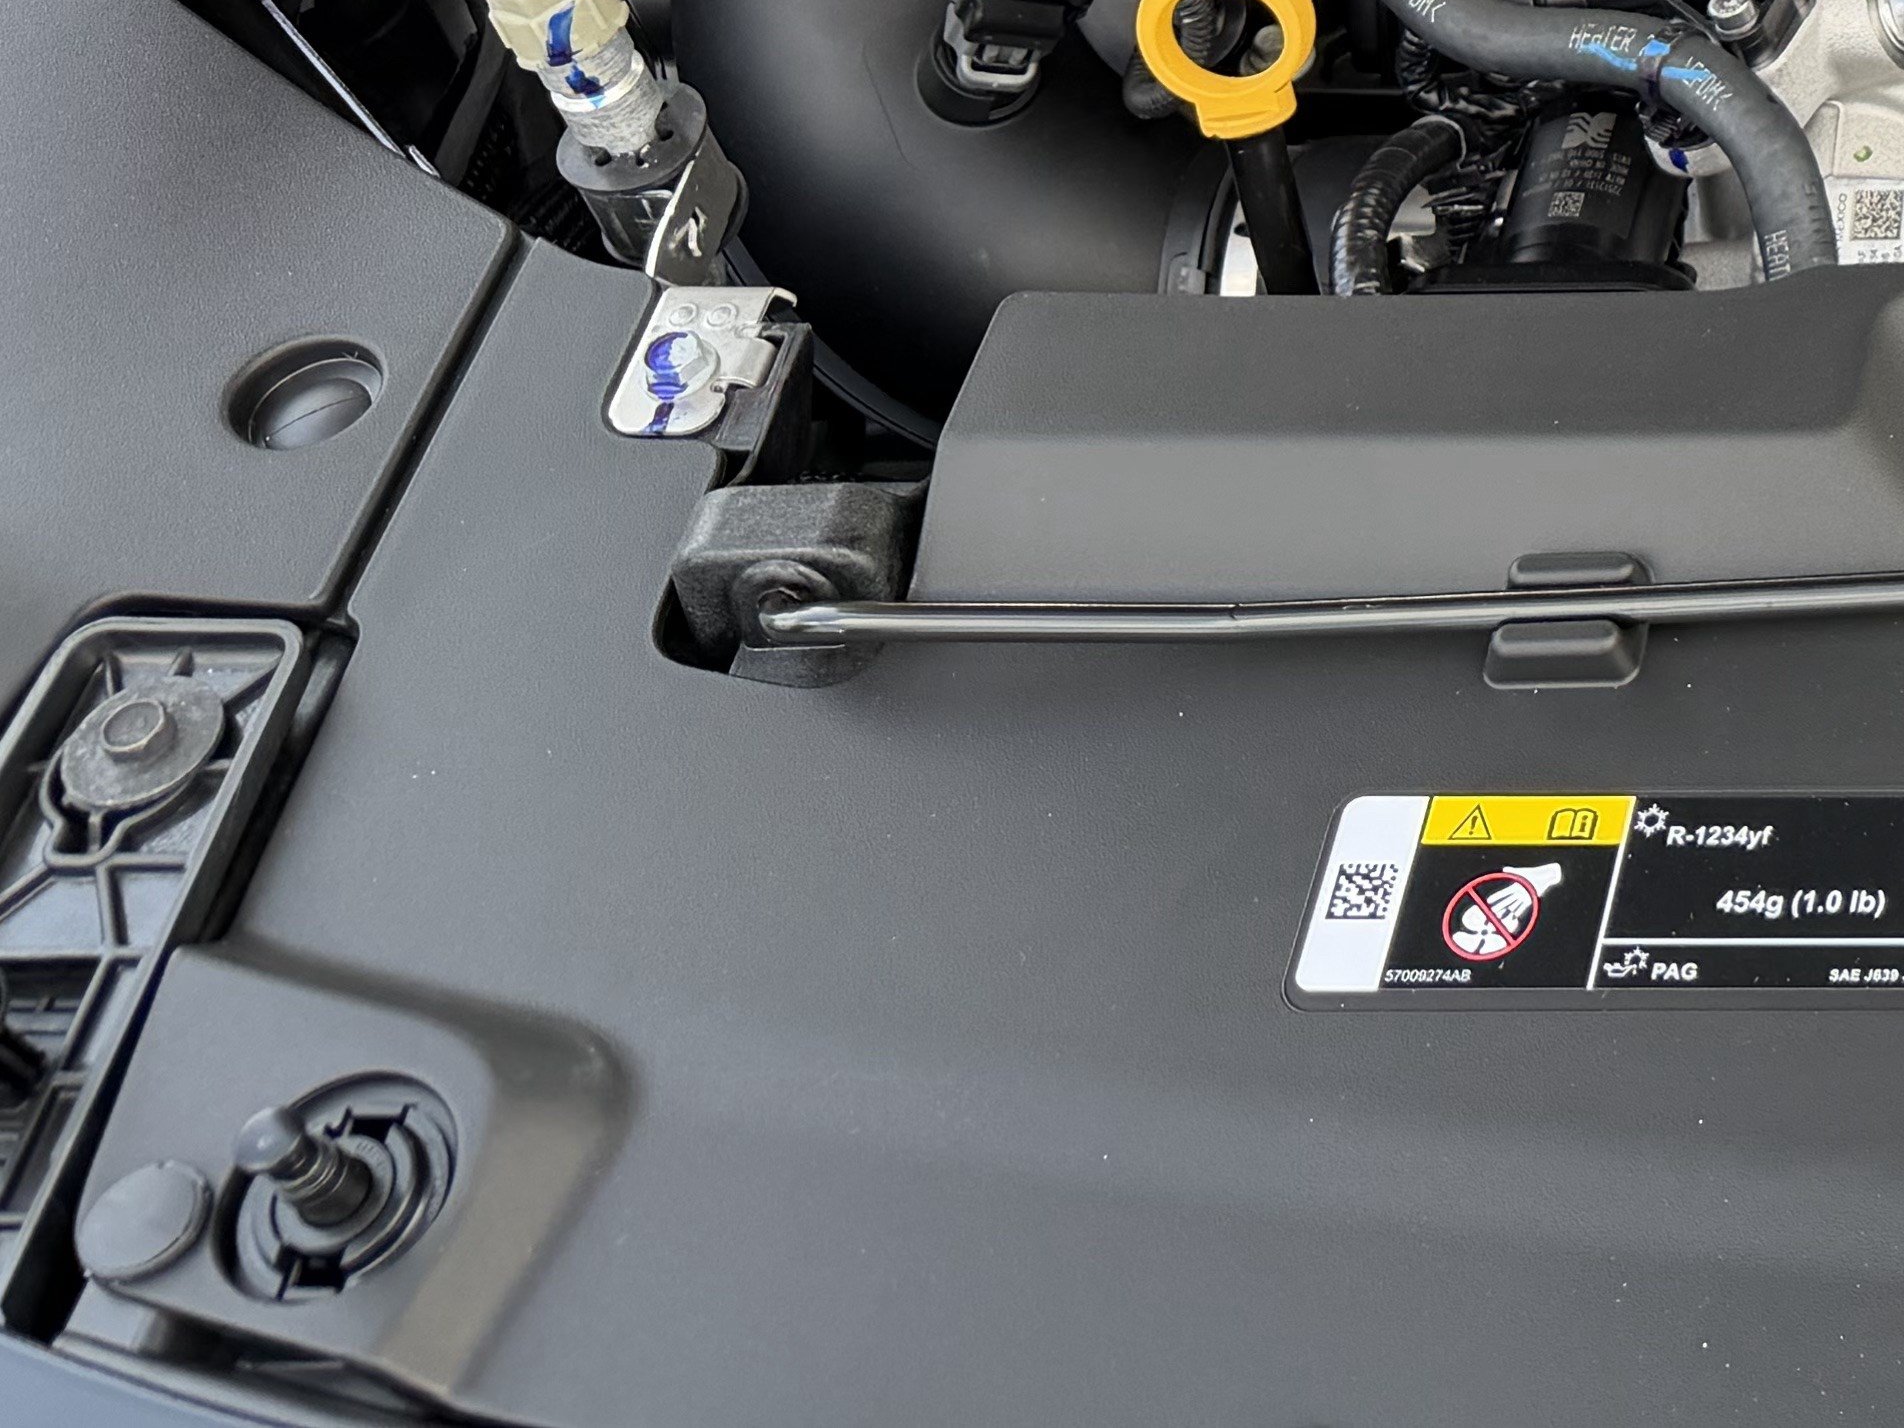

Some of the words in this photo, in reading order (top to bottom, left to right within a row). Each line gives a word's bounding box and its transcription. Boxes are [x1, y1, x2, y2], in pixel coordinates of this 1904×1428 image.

[1568, 23, 1638, 53] HEATER
[1666, 825, 1774, 851] R-1234yf
[1716, 890, 1784, 919] 454g
[1791, 890, 1842, 919] (1.0
[1850, 890, 1887, 919] lb)
[1651, 962, 1699, 981] PAG
[1829, 968, 1860, 983] SAE
